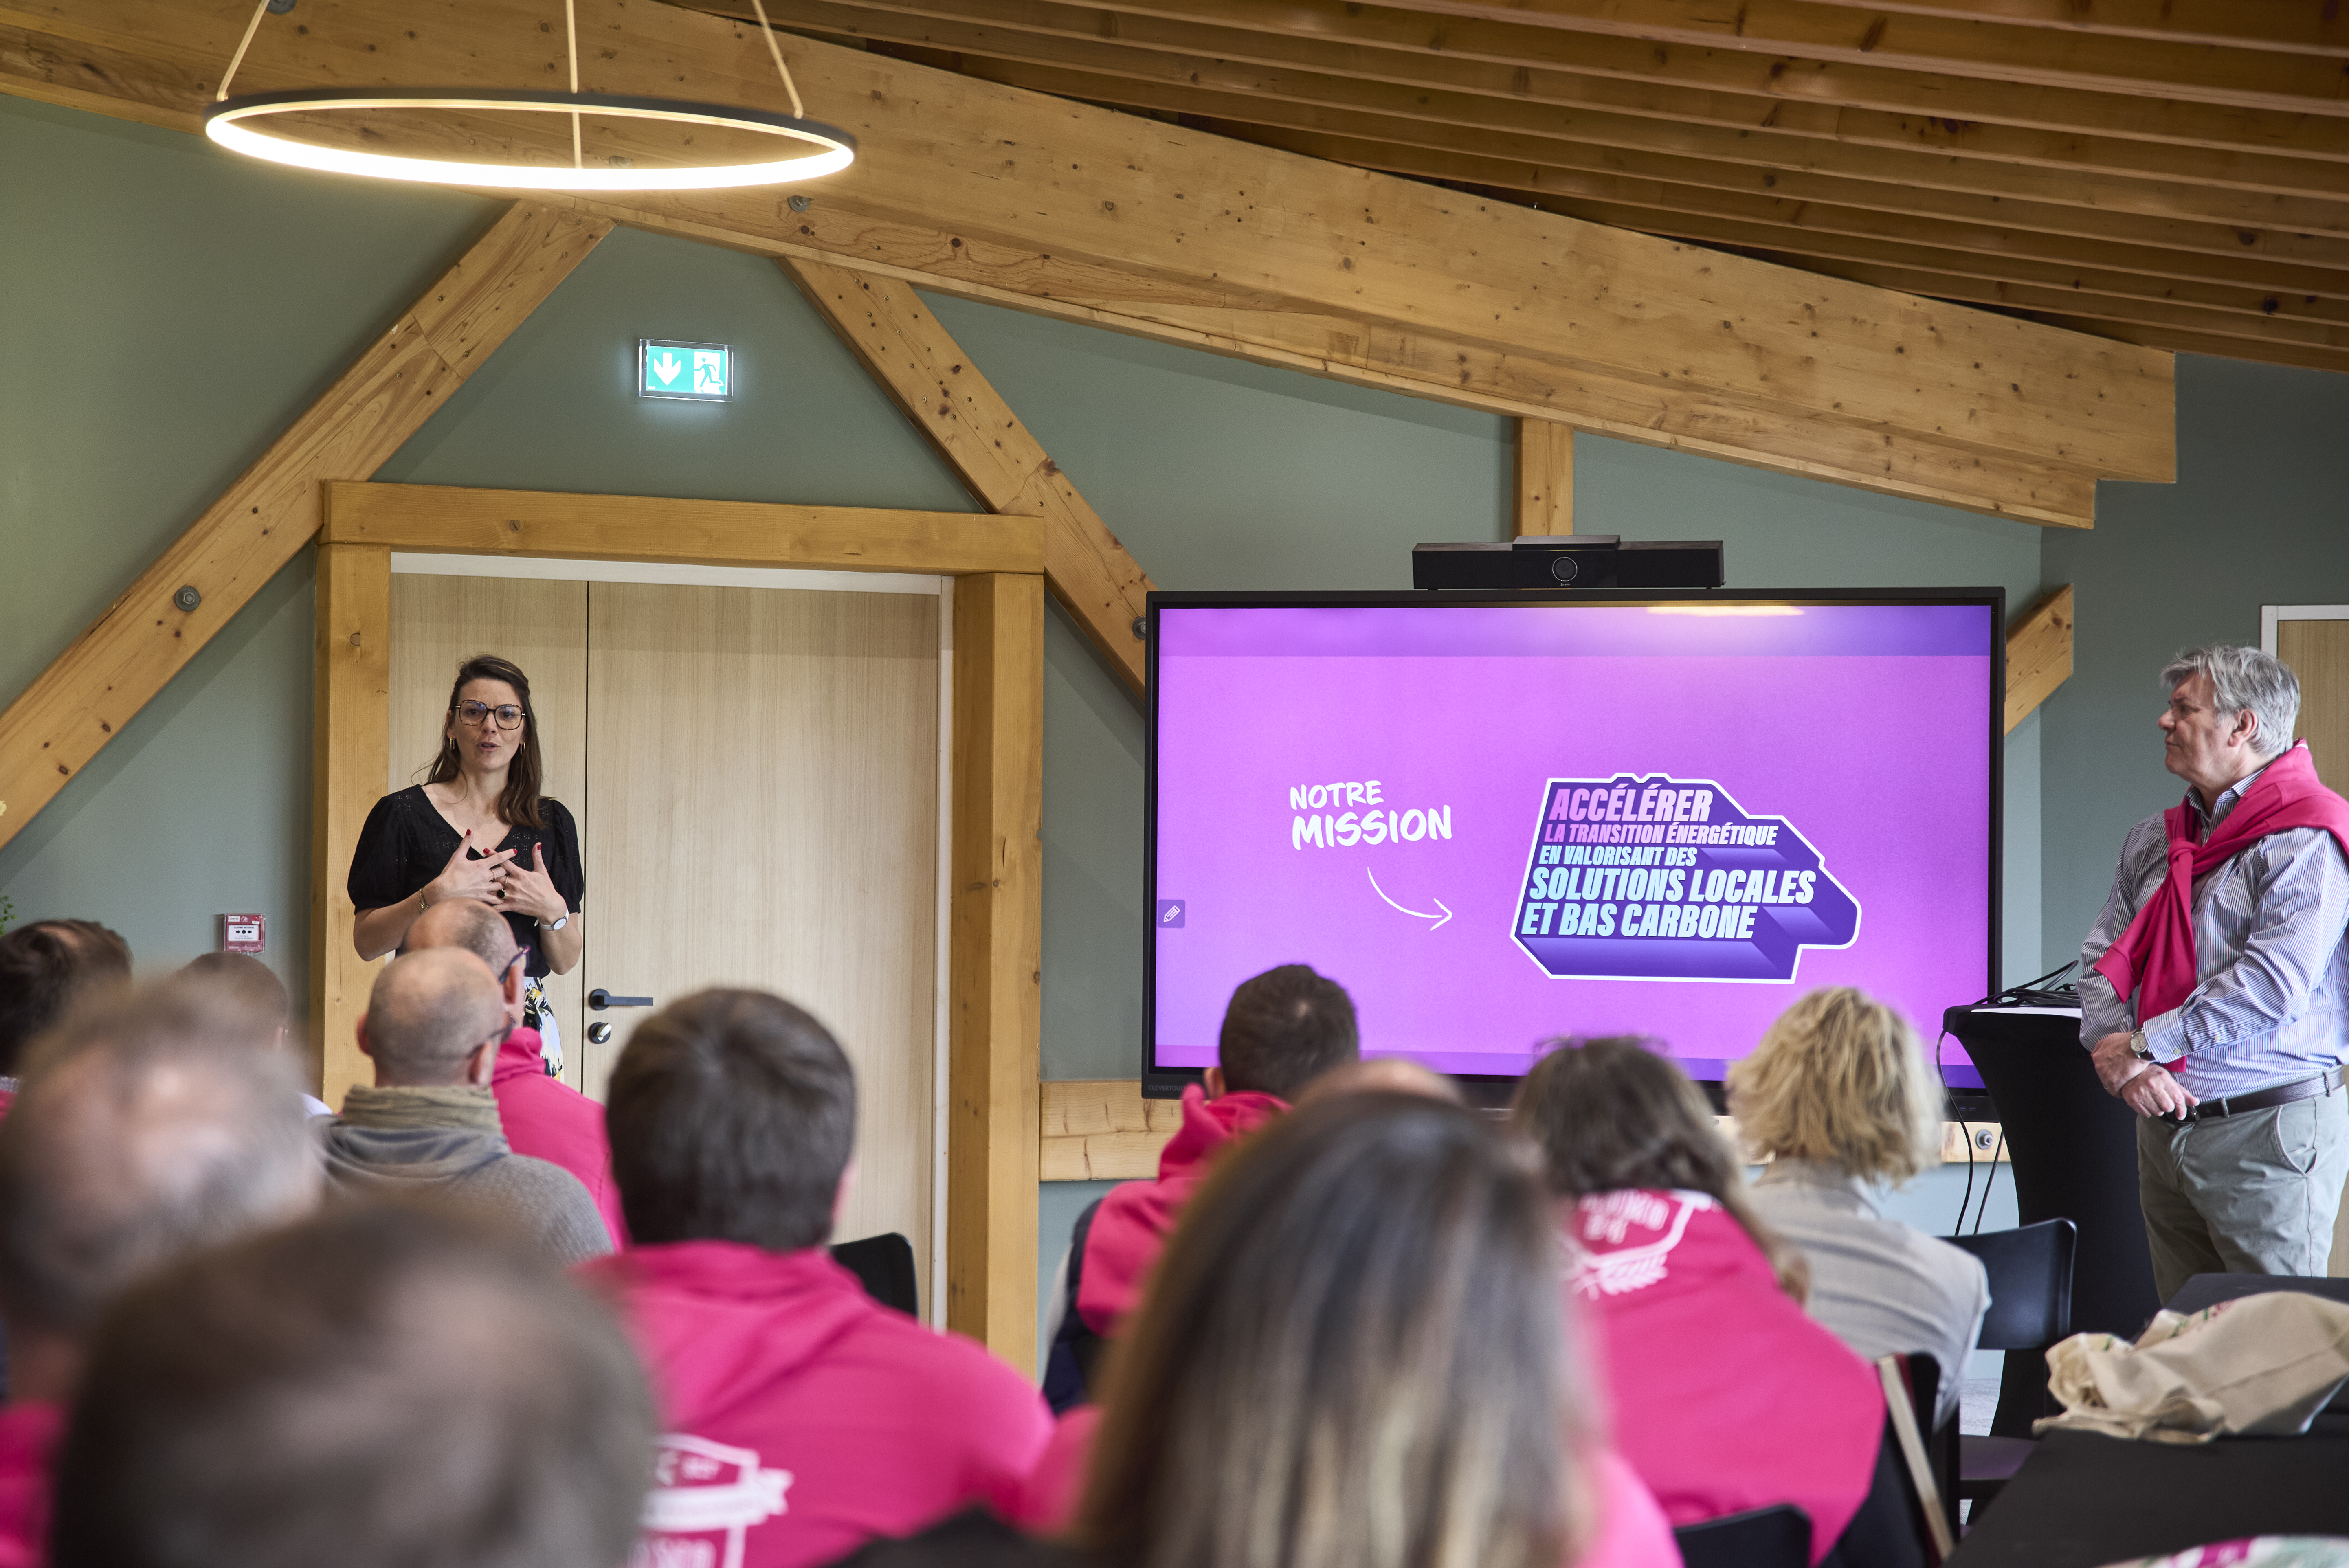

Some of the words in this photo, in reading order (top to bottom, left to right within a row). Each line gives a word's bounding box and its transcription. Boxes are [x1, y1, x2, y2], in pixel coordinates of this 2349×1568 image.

[1290, 780, 1384, 810] NOTRE
[1549, 783, 1713, 822] ACCÉLÉRER
[1292, 805, 1452, 850] MISSION
[1544, 824, 1565, 842] LA
[1569, 824, 1666, 844] TRANSITION
[1665, 821, 1779, 846] ÉNERGÉTIQUE
[1539, 845, 1562, 865] EN
[1564, 846, 1665, 866] VALORISANT
[1664, 847, 1698, 867] DES
[1529, 867, 1686, 902] SOLUTIONS
[1688, 869, 1816, 904] LOCALES
[1521, 902, 1559, 935] ET
[1558, 903, 1617, 936] BAS
[1621, 903, 1758, 938] CARBONE
